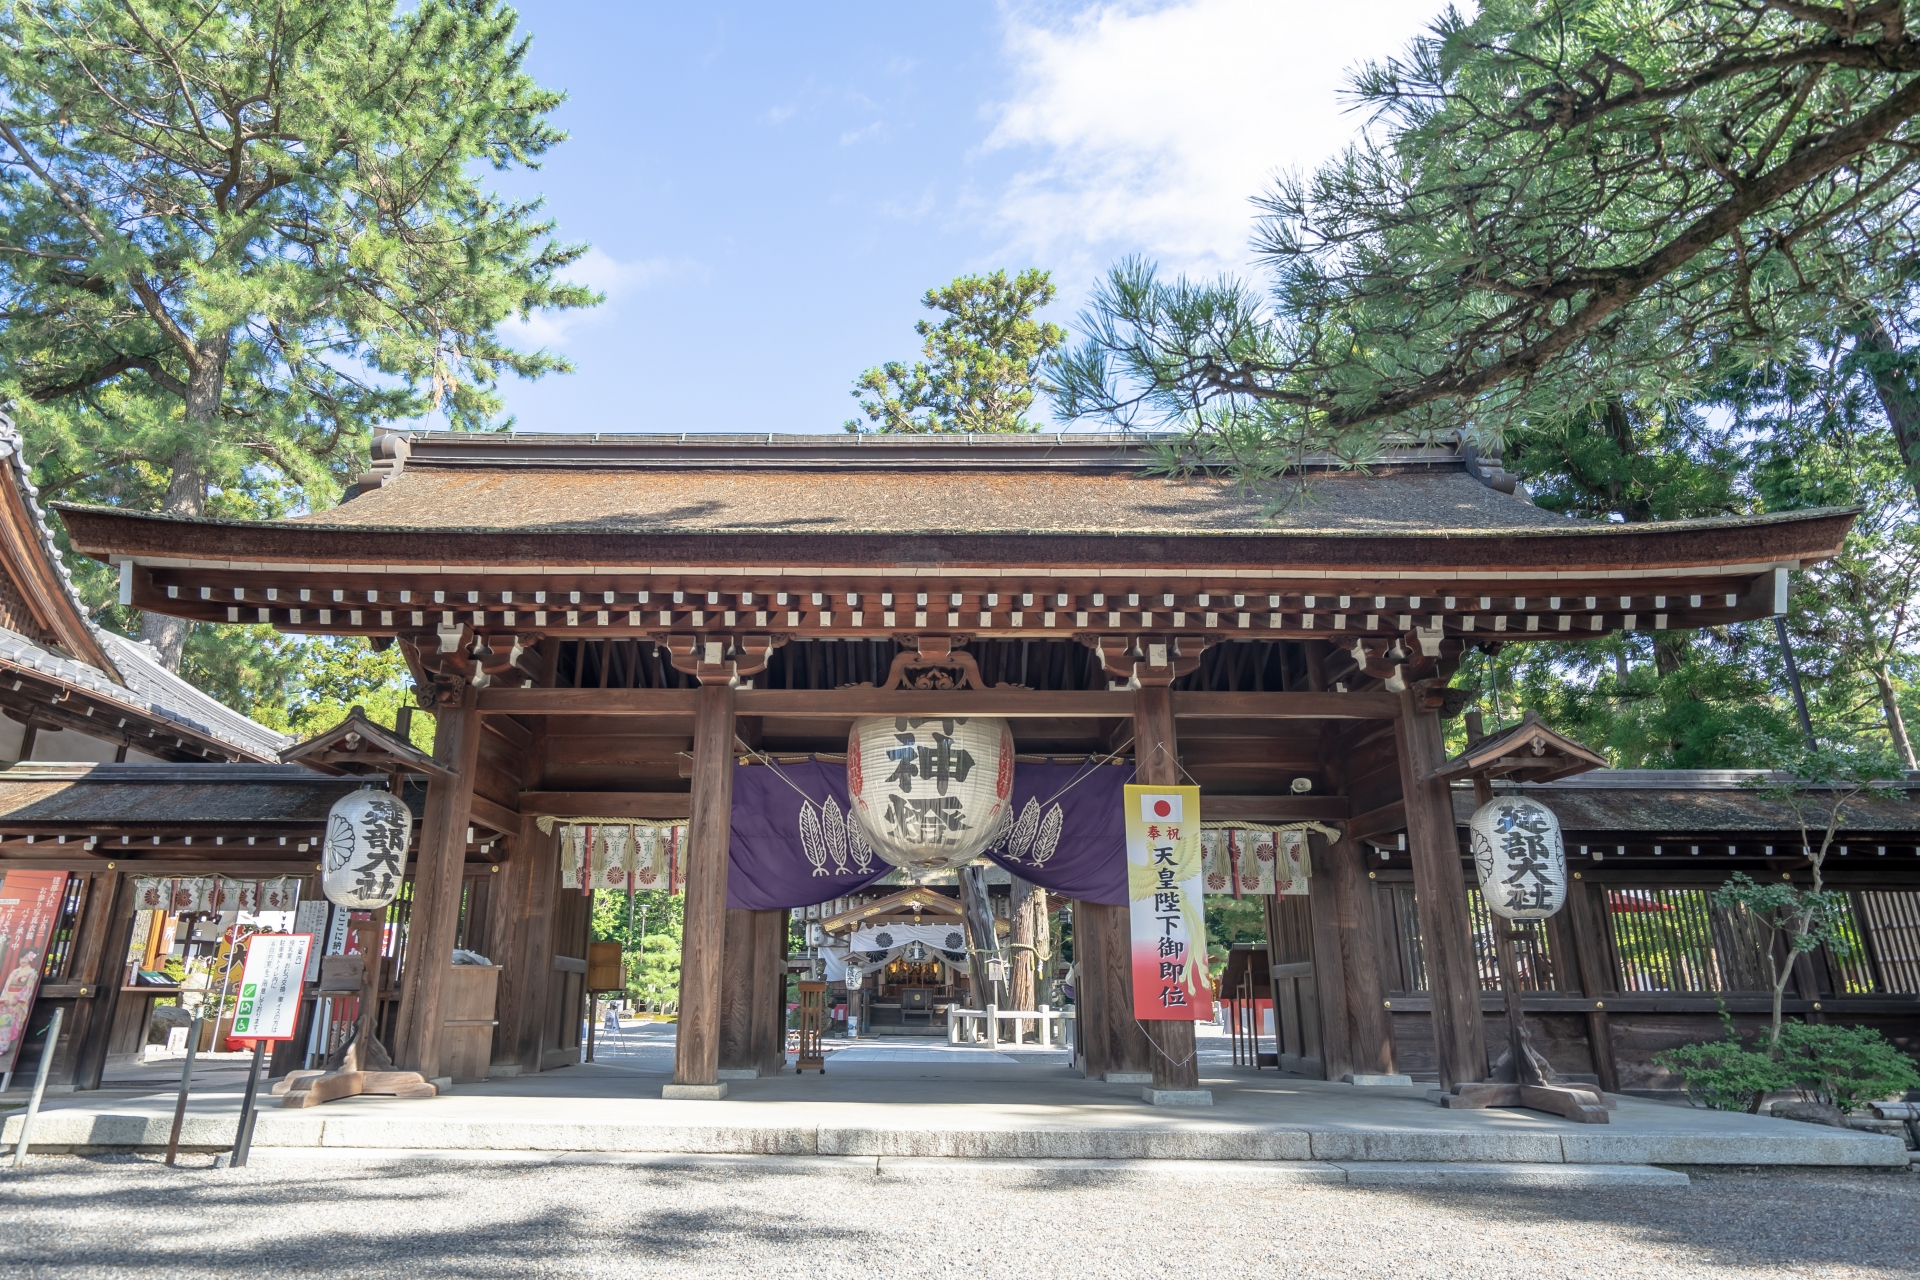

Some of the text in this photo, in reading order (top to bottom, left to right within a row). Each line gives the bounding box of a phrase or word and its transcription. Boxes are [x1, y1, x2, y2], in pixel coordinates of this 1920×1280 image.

[346, 800, 407, 900] 建部大社
[1147, 825, 1181, 841] 奉祝
[1494, 804, 1558, 911] 建部大社
[46, 876, 61, 907] 建部大社
[1154, 846, 1188, 1008] 天皇陛下御即位
